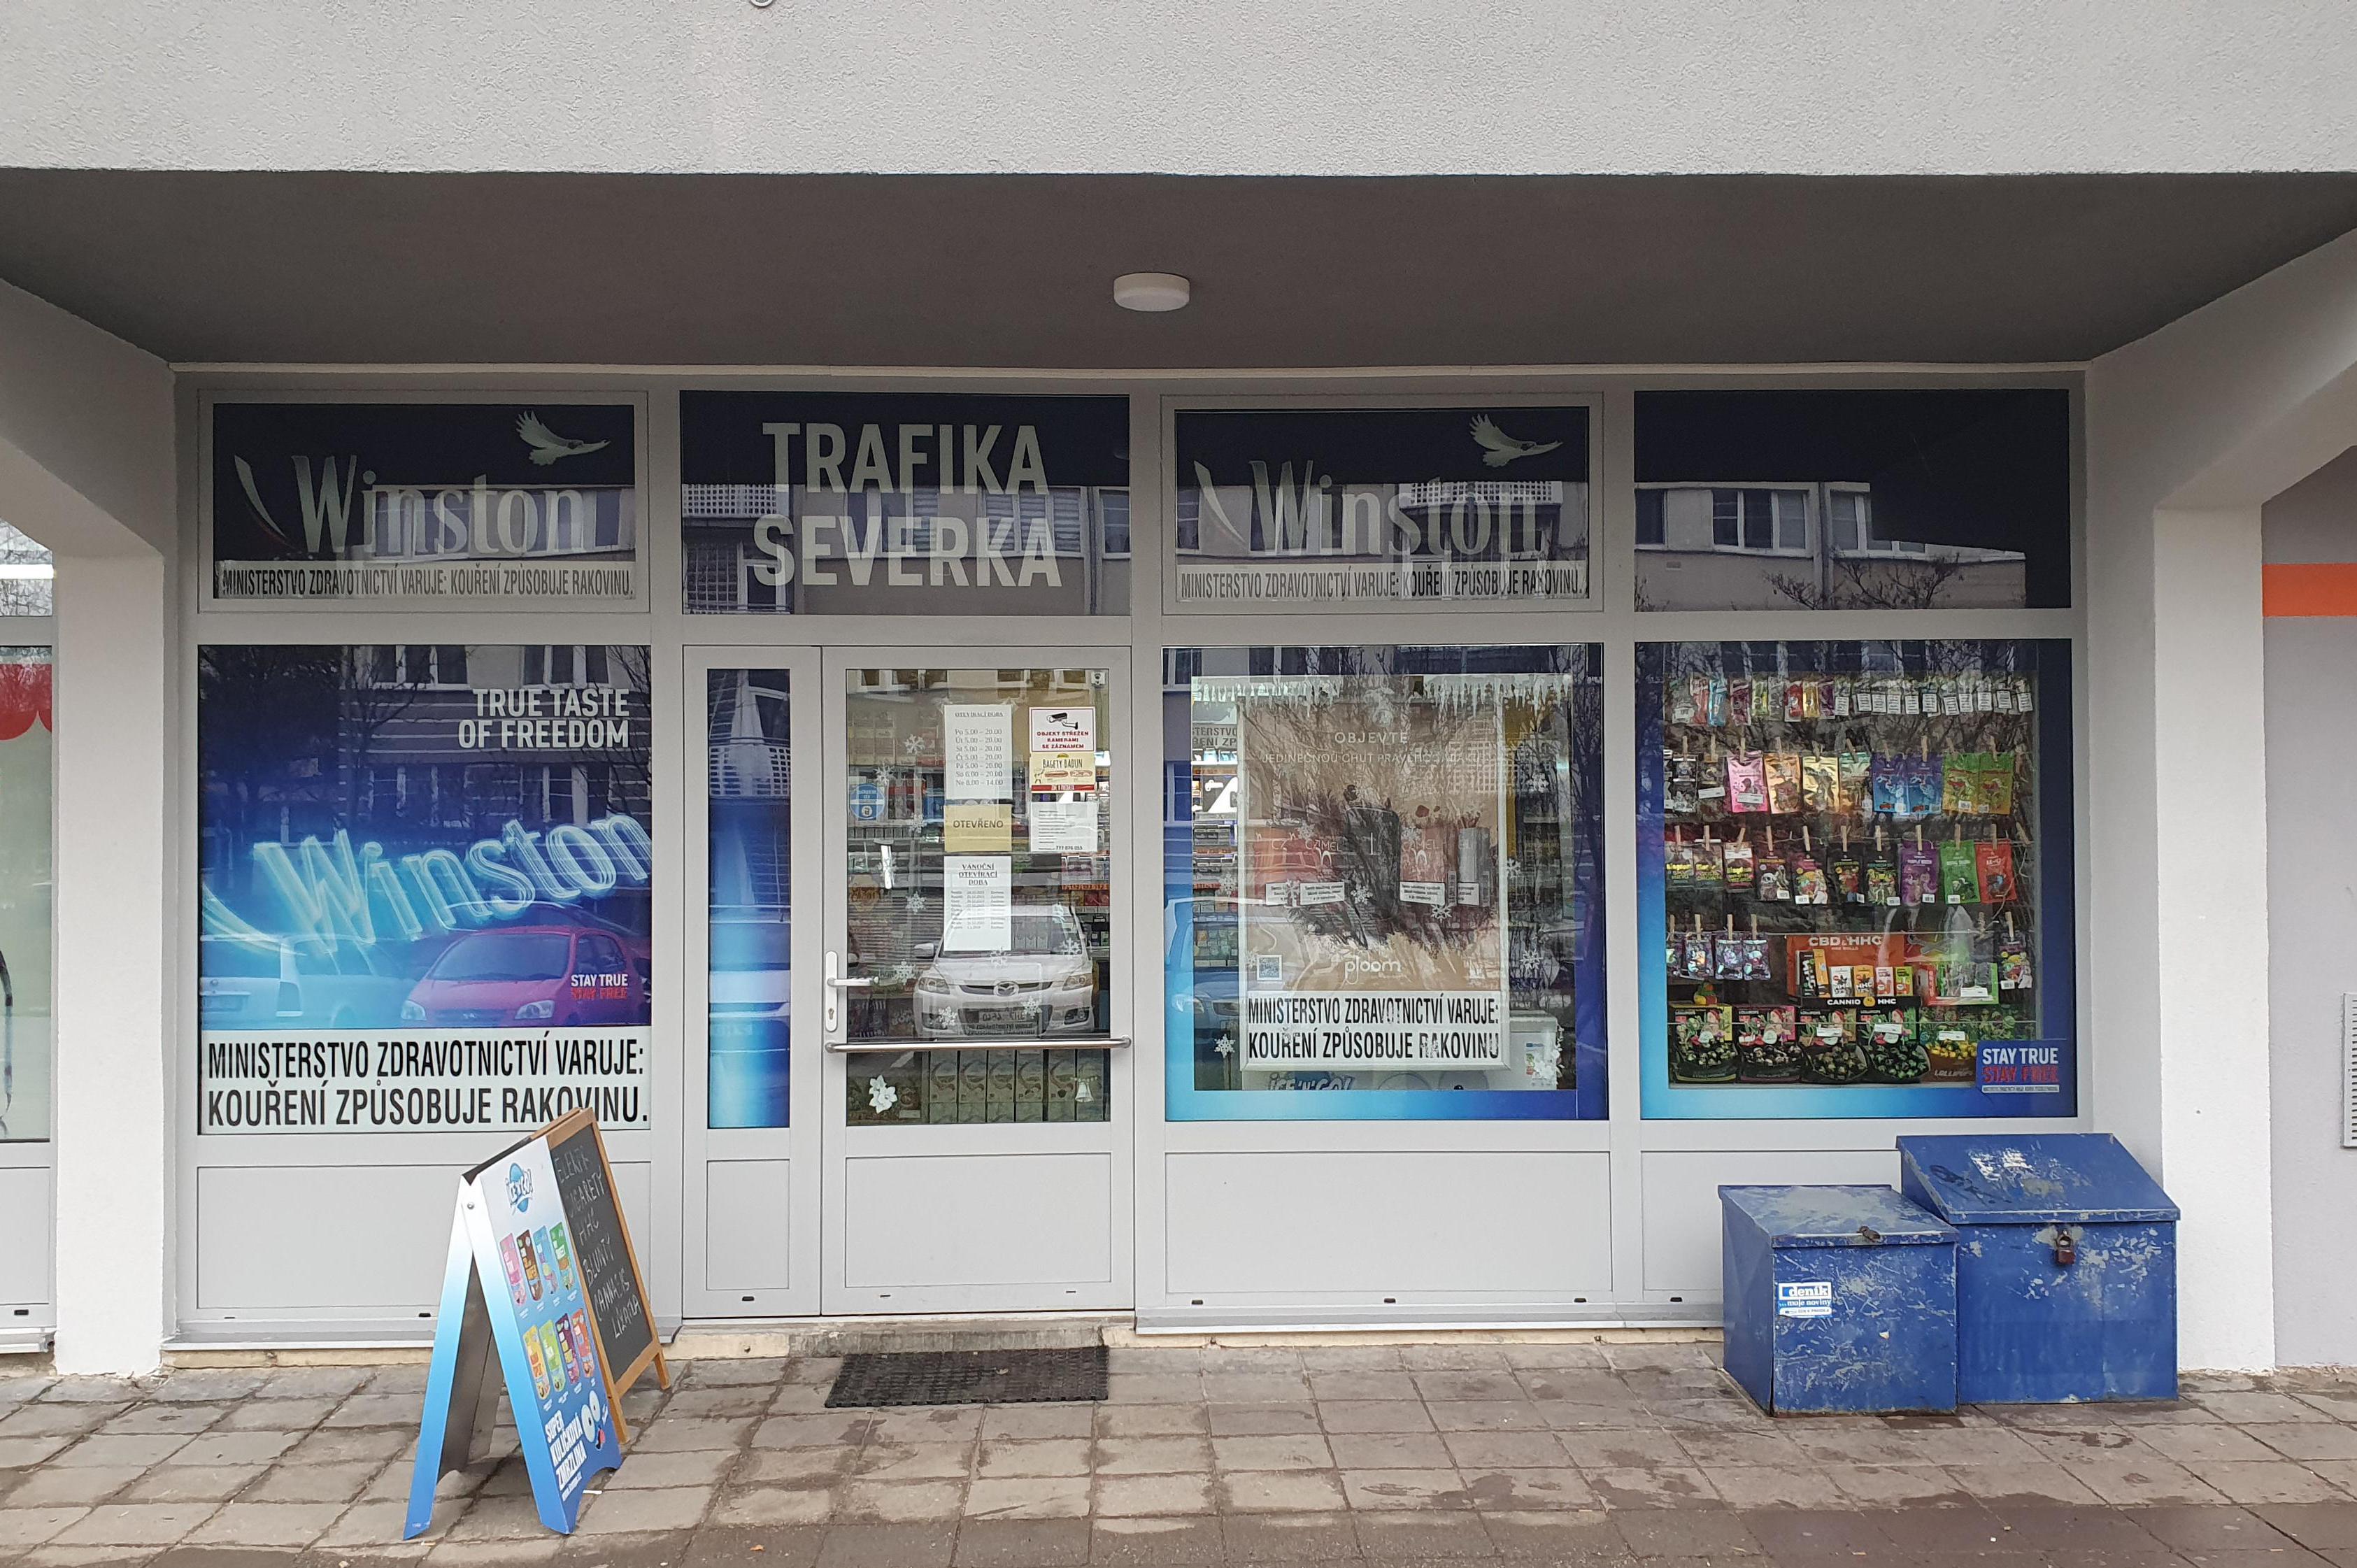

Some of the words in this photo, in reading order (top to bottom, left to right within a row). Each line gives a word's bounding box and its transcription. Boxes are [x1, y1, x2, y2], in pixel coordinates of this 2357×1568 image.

[762, 422, 1048, 494] TRAFIKA
[291, 455, 597, 554] Winston
[1248, 459, 1544, 557] Winston
[753, 513, 1062, 587] SEVERKA
[222, 569, 306, 596] MINISTERSTVO
[308, 563, 399, 596] ZDRAVOTNICTVÍ
[401, 569, 448, 595] VARUJE:
[450, 563, 501, 596] KOUŘENÍ
[504, 562, 569, 596] ZPŮSOBUJE
[572, 569, 634, 596] RAKOVINU.
[1181, 570, 1261, 598] MINISTERSTVO
[1265, 565, 1352, 597] ZDRAVOTNICTVÍ
[1354, 571, 1400, 597] VARUJE:
[1402, 564, 1452, 597] KOUŘENÍ
[472, 688, 543, 718] TRUE
[549, 688, 630, 717] TASTE
[457, 720, 491, 748] OF
[501, 720, 629, 748] FREEDOM
[1334, 732, 1409, 744] OBJEVTE
[1042, 759, 1062, 769] BAGETY
[953, 818, 1004, 829] OTEVŘENO
[253, 814, 652, 955] Winston
[1808, 936, 1841, 946] CBD
[1848, 936, 1882, 946] HHC
[571, 974, 597, 987] STAY
[599, 973, 629, 987] TRUE
[1344, 955, 1402, 985] ploom
[1248, 997, 1341, 1024] MINISTERSTVO
[1344, 993, 1444, 1024] ZDRAVOTNICTVÍ
[1447, 998, 1499, 1025] VARUJE:
[208, 1041, 369, 1079] MINISTERSTVO
[378, 1030, 549, 1078] ZDRAVOTNICTVÍ
[555, 1038, 645, 1076] VARUJE:
[1248, 1027, 1318, 1059] KOUŘENÍ
[1323, 1026, 1413, 1059] ZPŮSOBUJE
[1982, 1048, 2016, 1064] STAY
[2019, 1048, 2059, 1064] TRUE
[1982, 1065, 2017, 1083] STAY
[208, 1080, 329, 1127] KOUŘENÍ
[336, 1078, 492, 1125] ZPŮSOBUJE
[501, 1084, 648, 1123] RAKOVINU.
[583, 1232, 615, 1288] BLUNTY
[545, 1409, 564, 1444] SUPER
[550, 1411, 584, 1467] KULIČKOVÁ
[555, 1439, 588, 1491] ZMRZLINA
